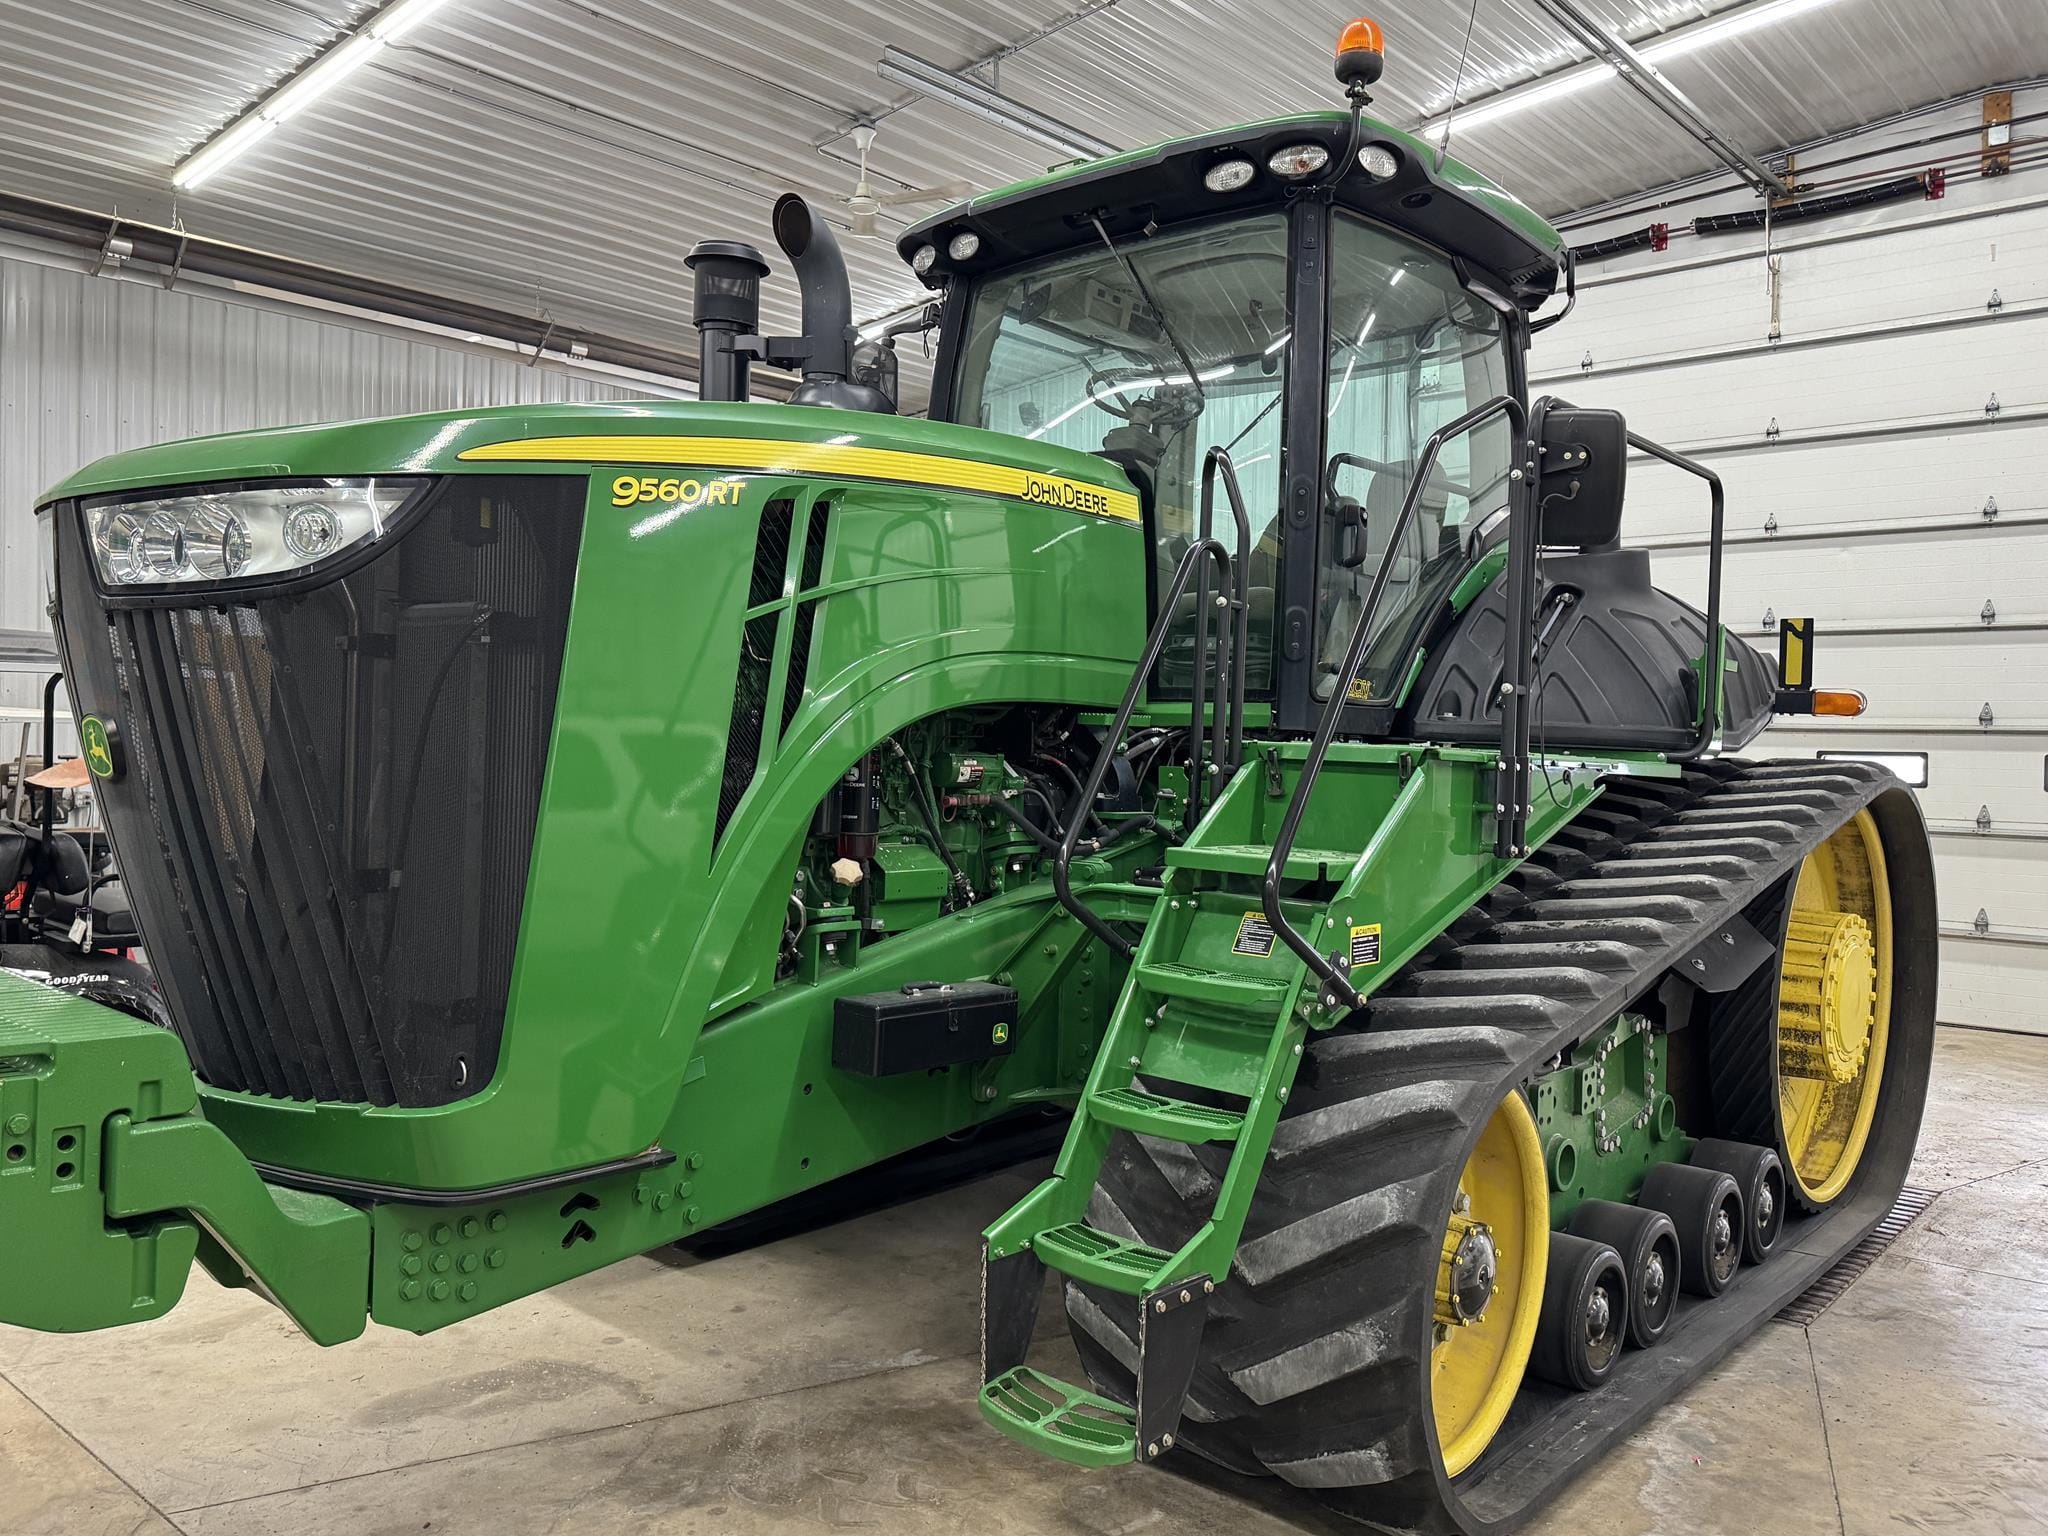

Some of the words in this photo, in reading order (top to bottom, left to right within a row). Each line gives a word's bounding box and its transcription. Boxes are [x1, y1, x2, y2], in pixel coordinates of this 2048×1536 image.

[611, 475, 702, 507] 9560
[706, 479, 747, 506] RT
[1021, 475, 1063, 504] JOHN
[1063, 483, 1109, 513] DEERE
[45, 973, 109, 985] GOODYEAR
